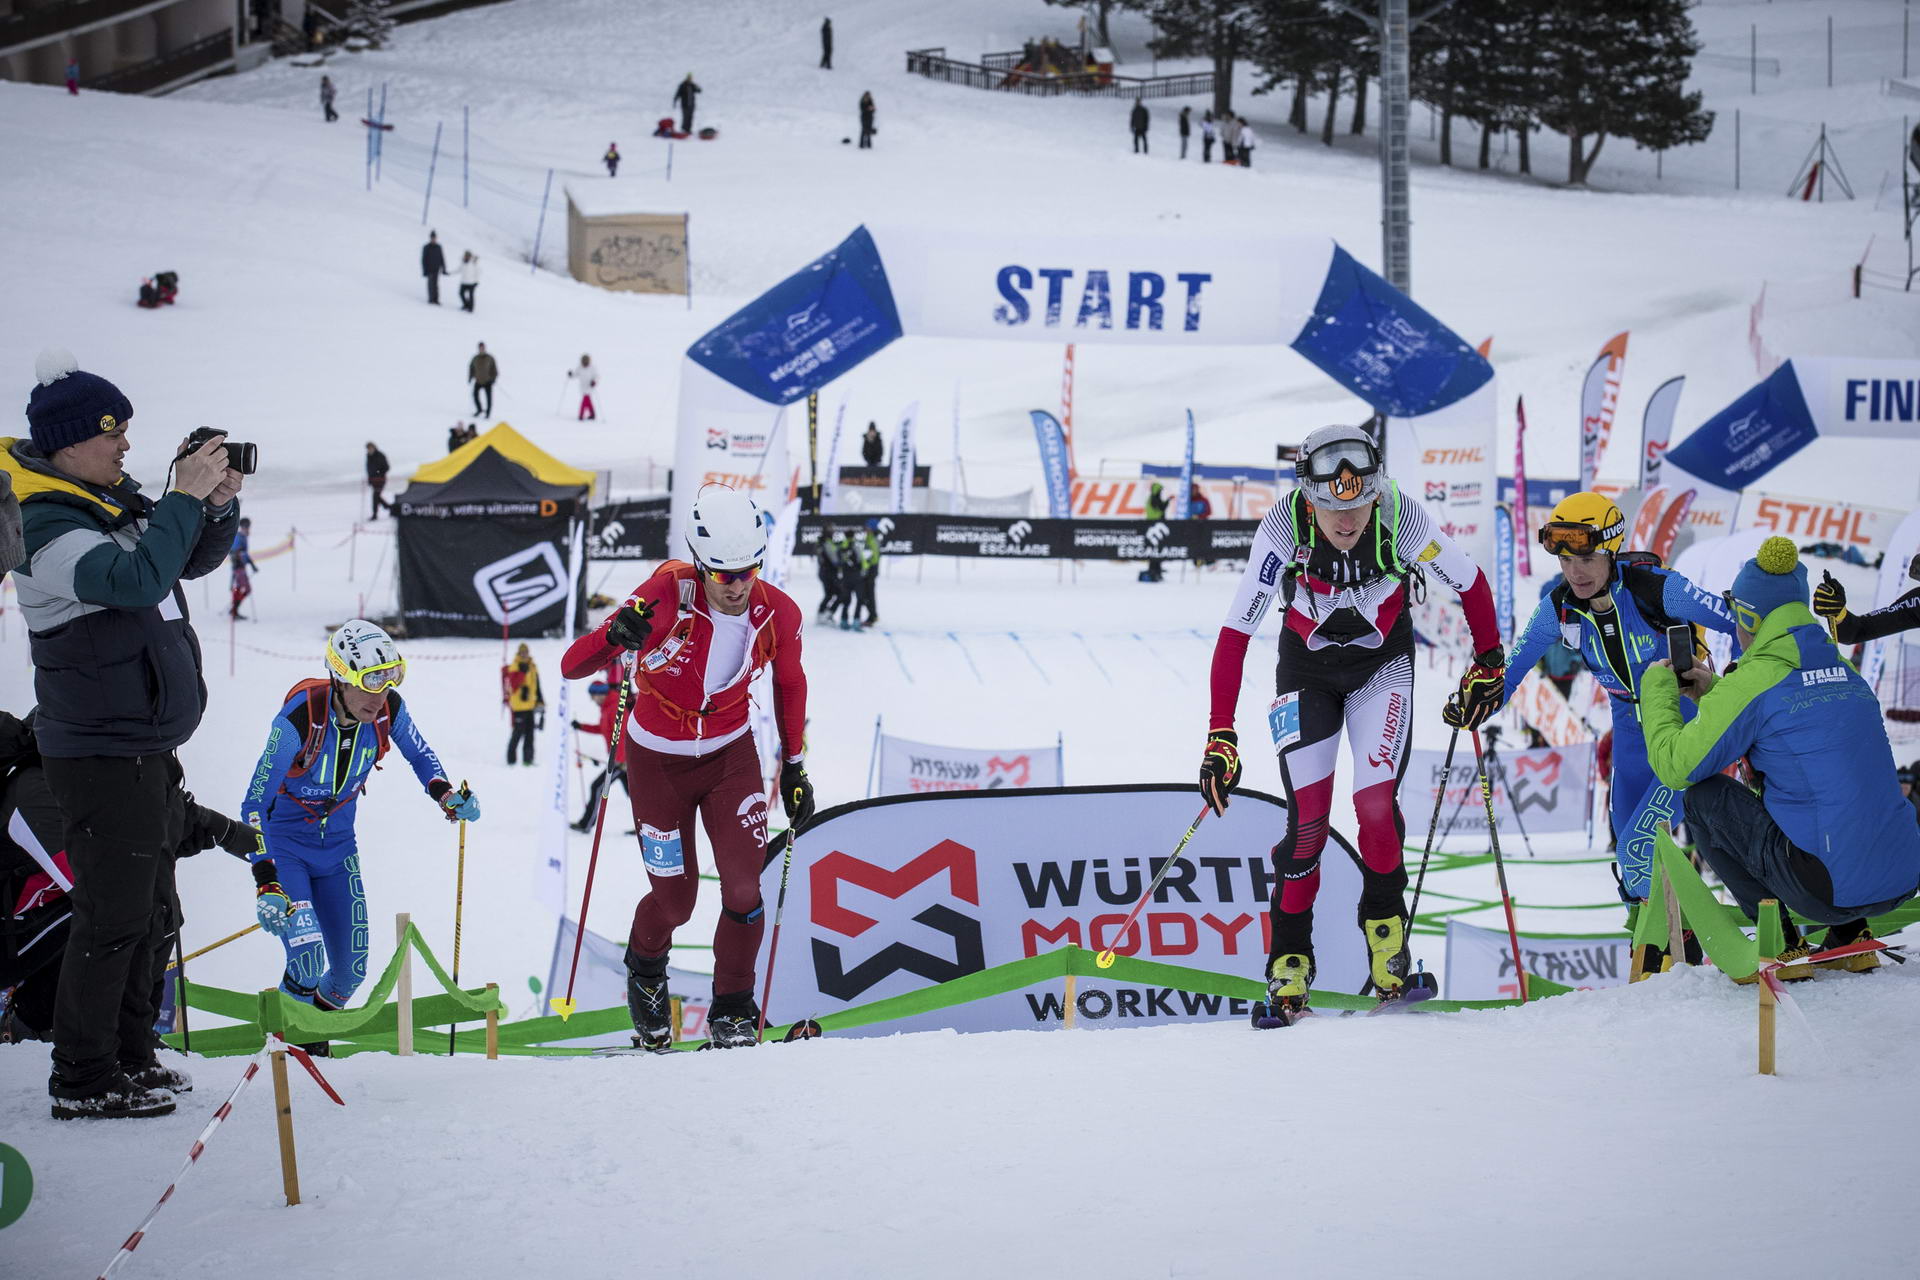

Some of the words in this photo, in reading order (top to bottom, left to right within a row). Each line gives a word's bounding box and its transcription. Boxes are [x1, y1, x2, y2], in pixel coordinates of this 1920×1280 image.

[993, 265, 1212, 331] START
[1845, 379, 1920, 422] FIN
[1422, 448, 1485, 464] STIHL
[540, 500, 558, 517] D
[1603, 519, 1625, 540] uvex
[1752, 497, 1872, 545] STIHL
[936, 531, 1007, 543] MONTAGNE
[1073, 534, 1145, 547] MONTAGNE
[1210, 535, 1256, 548] MONT
[980, 544, 1051, 556] ESCALADE
[1117, 547, 1188, 558] ESCALADE
[1261, 554, 1276, 582] pure
[1241, 590, 1266, 622] Lenzing
[1683, 582, 1734, 621] ITALI
[343, 628, 361, 660] CAMP
[1801, 666, 1847, 681] ITALIA
[1274, 712, 1287, 731] 17
[1382, 692, 1402, 744] AUSTRIA
[1390, 696, 1408, 763] MOUNTAINEERING
[1624, 784, 1675, 891] KARP
[654, 846, 663, 860] 9
[296, 914, 313, 928] 45
[1021, 911, 1272, 959] MODY
[1025, 987, 1263, 1022] WORKWE
